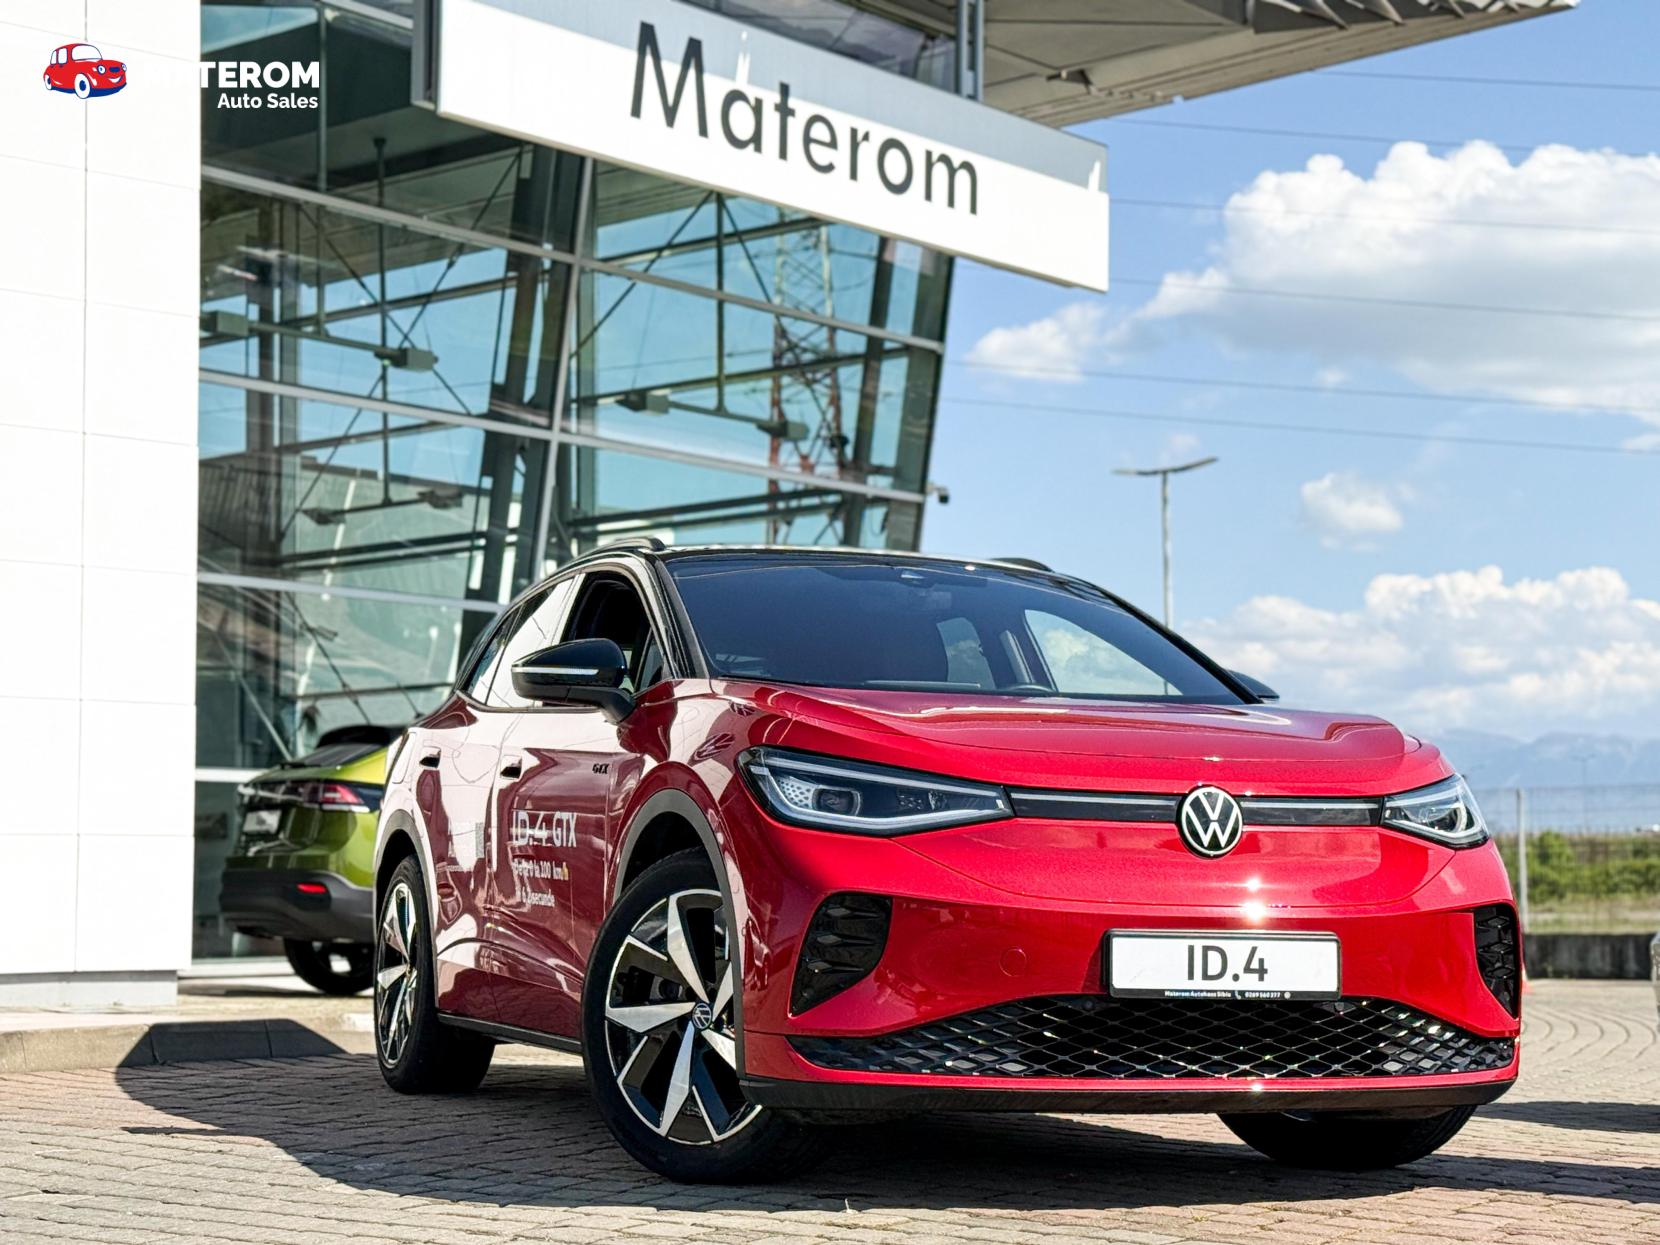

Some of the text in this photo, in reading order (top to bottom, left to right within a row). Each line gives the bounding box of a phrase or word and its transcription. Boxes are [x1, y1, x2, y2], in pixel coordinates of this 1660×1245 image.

[630, 21, 977, 216] Materom
[553, 811, 577, 848] GTX
[1187, 945, 1268, 982] ID.4
